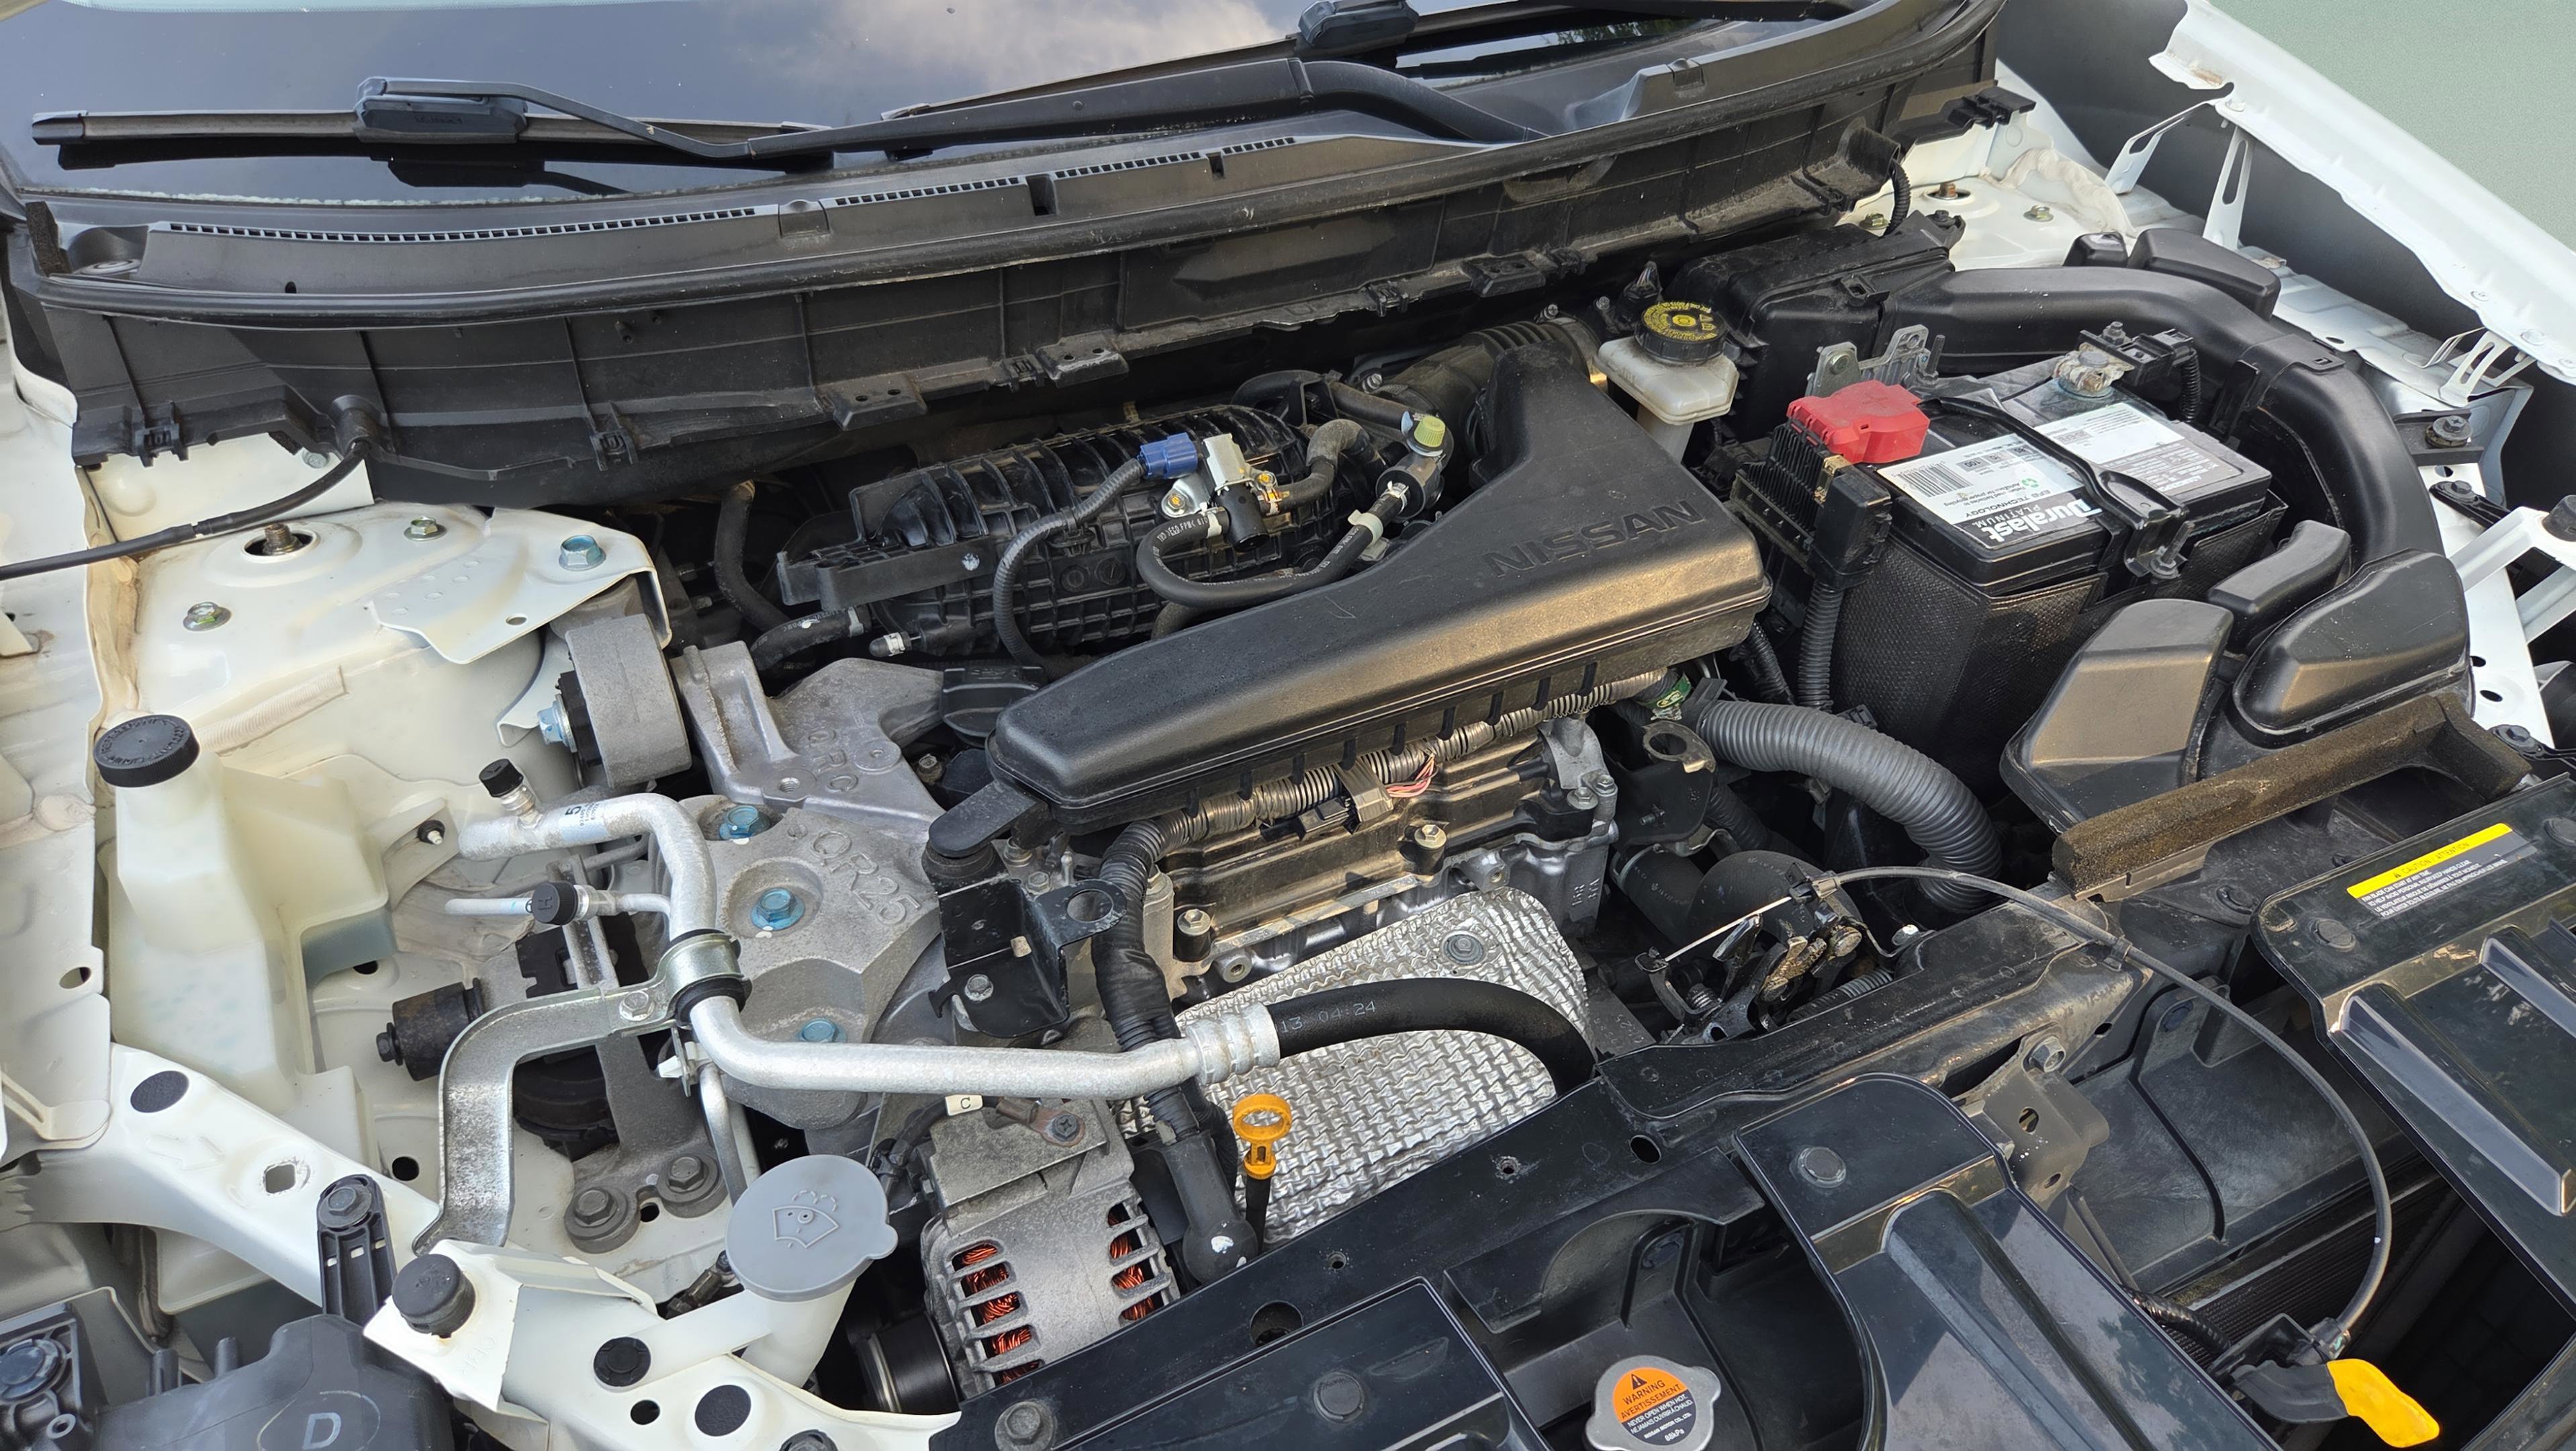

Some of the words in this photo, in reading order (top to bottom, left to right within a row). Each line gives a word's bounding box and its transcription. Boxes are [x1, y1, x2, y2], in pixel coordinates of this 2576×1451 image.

[1964, 494, 2030, 517] TECHNOLOGY
[1980, 496, 2102, 545] Duralast
[1481, 500, 1706, 579] NISSAN
[564, 804, 582, 818] 5
[2400, 858, 2432, 874] CAUTION
[2435, 841, 2470, 859] ATTENTION
[810, 828, 922, 926] QR25
[2369, 889, 2386, 898] BLADE
[2374, 895, 2388, 904] HELP
[2397, 881, 2421, 894] PERSONAL
[1280, 1016, 1304, 1034] 13
[960, 1096, 972, 1110] C
[1620, 1382, 1682, 1419] AVERTISSEMENT
[1622, 1379, 1666, 1405] WARNING
[1626, 1414, 1645, 1427] NEVER
[1643, 1407, 1660, 1419] OPEN
[1657, 1398, 1676, 1411] WHEN
[1673, 1393, 1688, 1403] HOT.
[1636, 1417, 1655, 1432] JAMAIS
[1653, 1409, 1672, 1423] OUVRIR
[1673, 1398, 1694, 1411] CHAUD.
[301, 1411, 342, 1450] D
[1643, 1427, 1661, 1439] NISSAN
